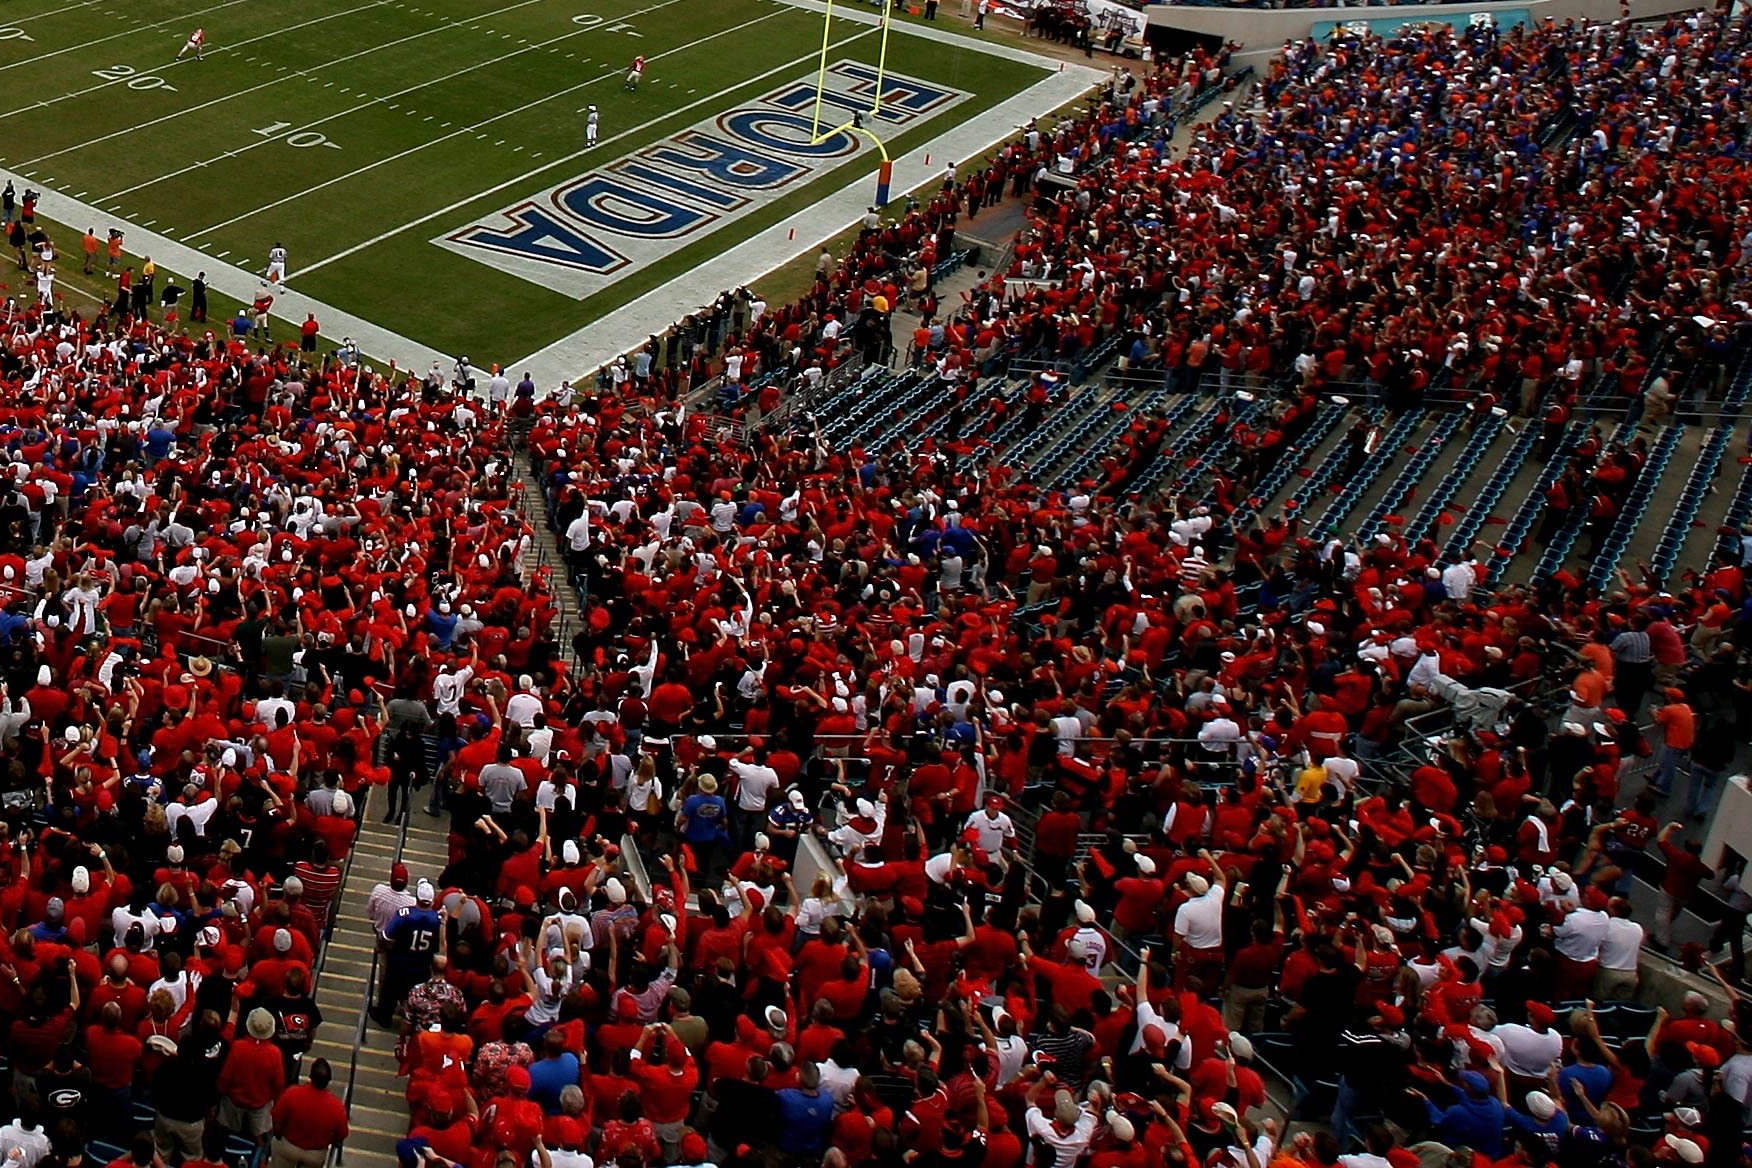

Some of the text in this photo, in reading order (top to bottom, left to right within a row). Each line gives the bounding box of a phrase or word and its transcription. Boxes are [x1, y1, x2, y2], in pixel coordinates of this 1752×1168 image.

[91, 64, 166, 92] 20
[251, 120, 327, 149] 10
[446, 64, 960, 275] FLORIDA
[885, 765, 895, 781] 7
[240, 828, 253, 849] 7
[410, 930, 433, 951] 15
